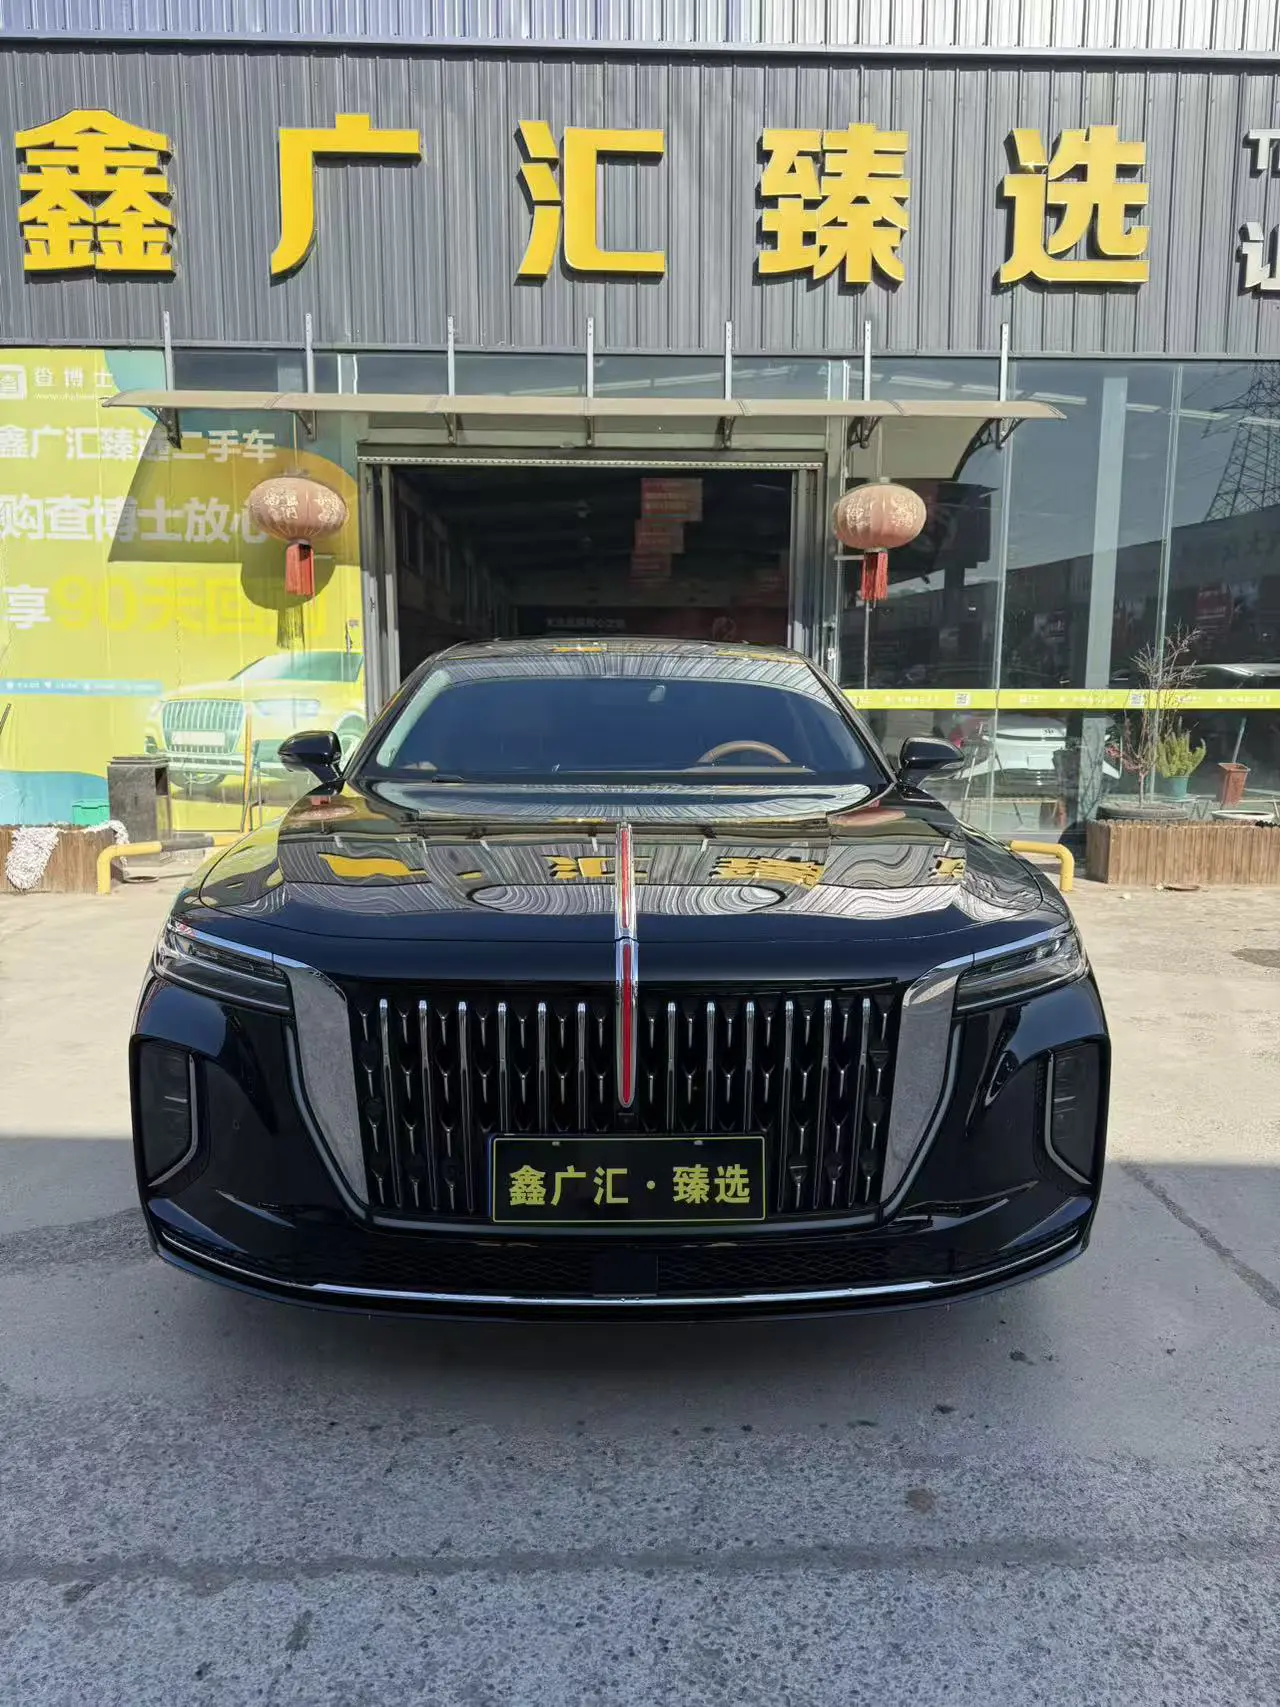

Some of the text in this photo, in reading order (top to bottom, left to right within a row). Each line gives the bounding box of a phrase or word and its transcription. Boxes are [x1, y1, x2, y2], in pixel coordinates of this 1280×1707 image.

[15, 109, 1149, 283] 鑫广汇臻选
